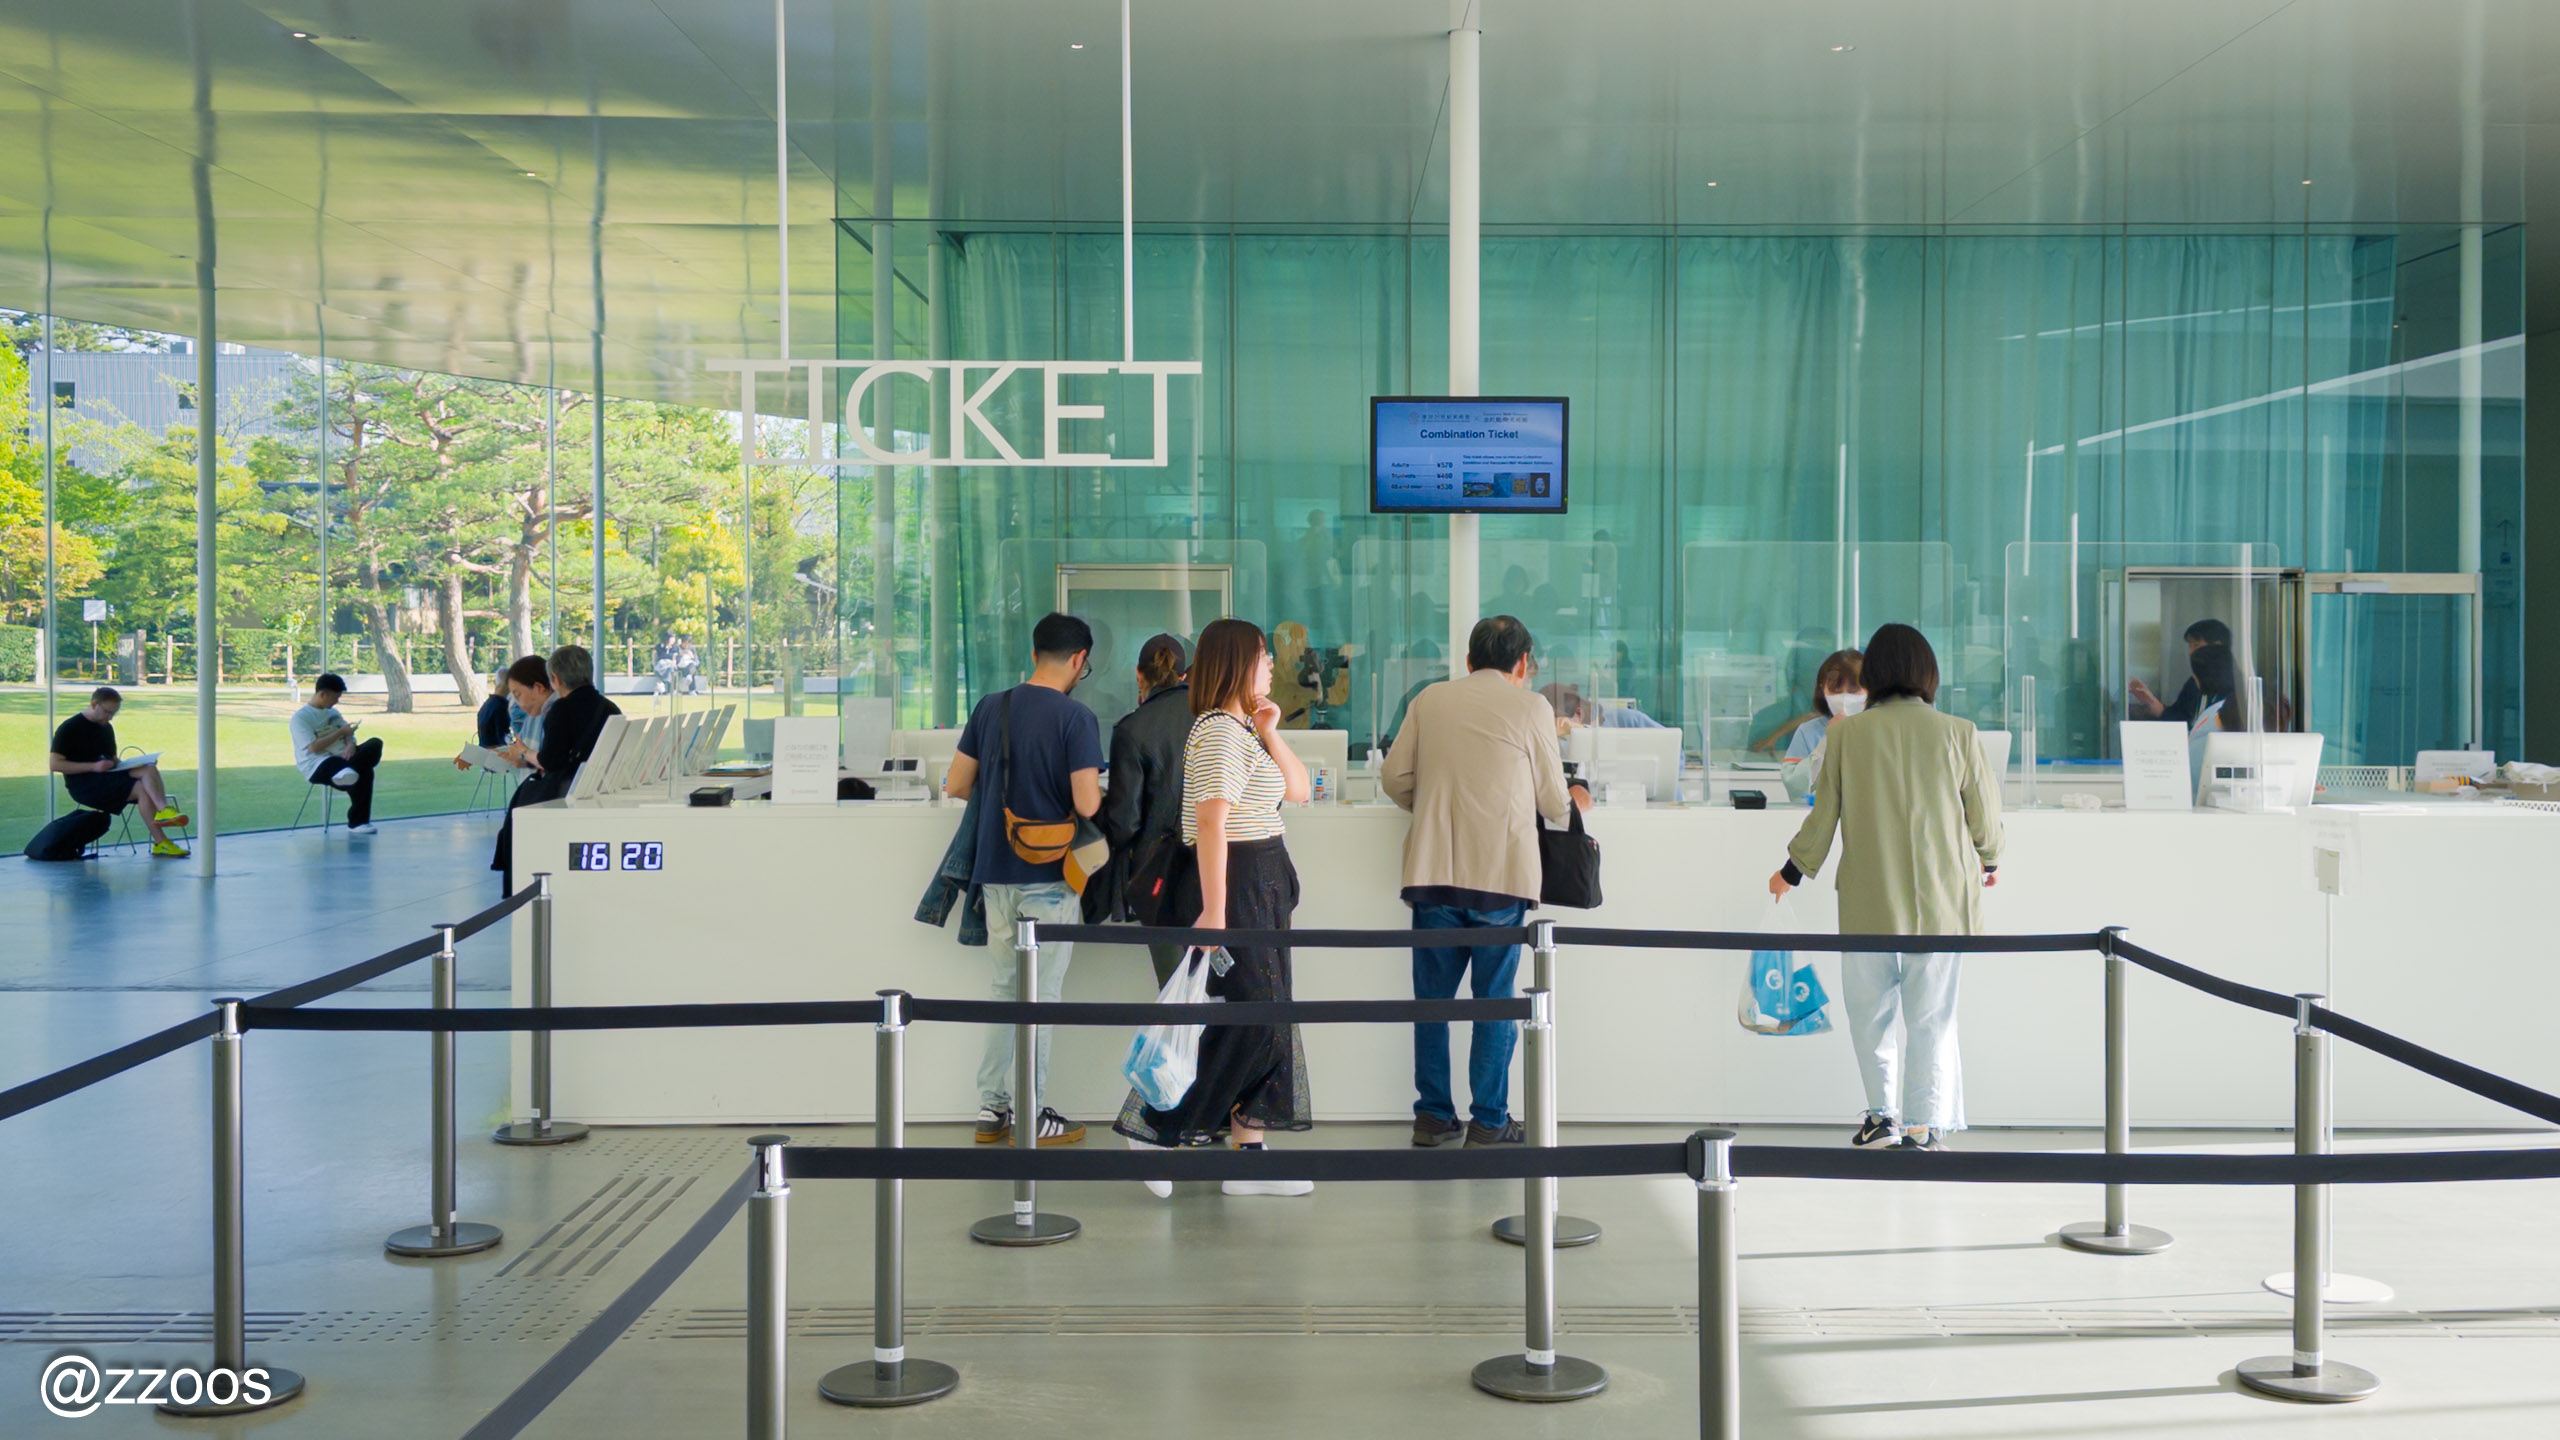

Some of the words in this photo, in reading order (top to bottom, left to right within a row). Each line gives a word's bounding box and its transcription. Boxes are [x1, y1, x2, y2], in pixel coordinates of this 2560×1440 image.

[706, 360, 1202, 467] TICKET
[1420, 429, 1485, 439] Combination
[1488, 429, 1519, 439] Ticket
[580, 843, 609, 870] 16
[622, 843, 662, 870] 20
